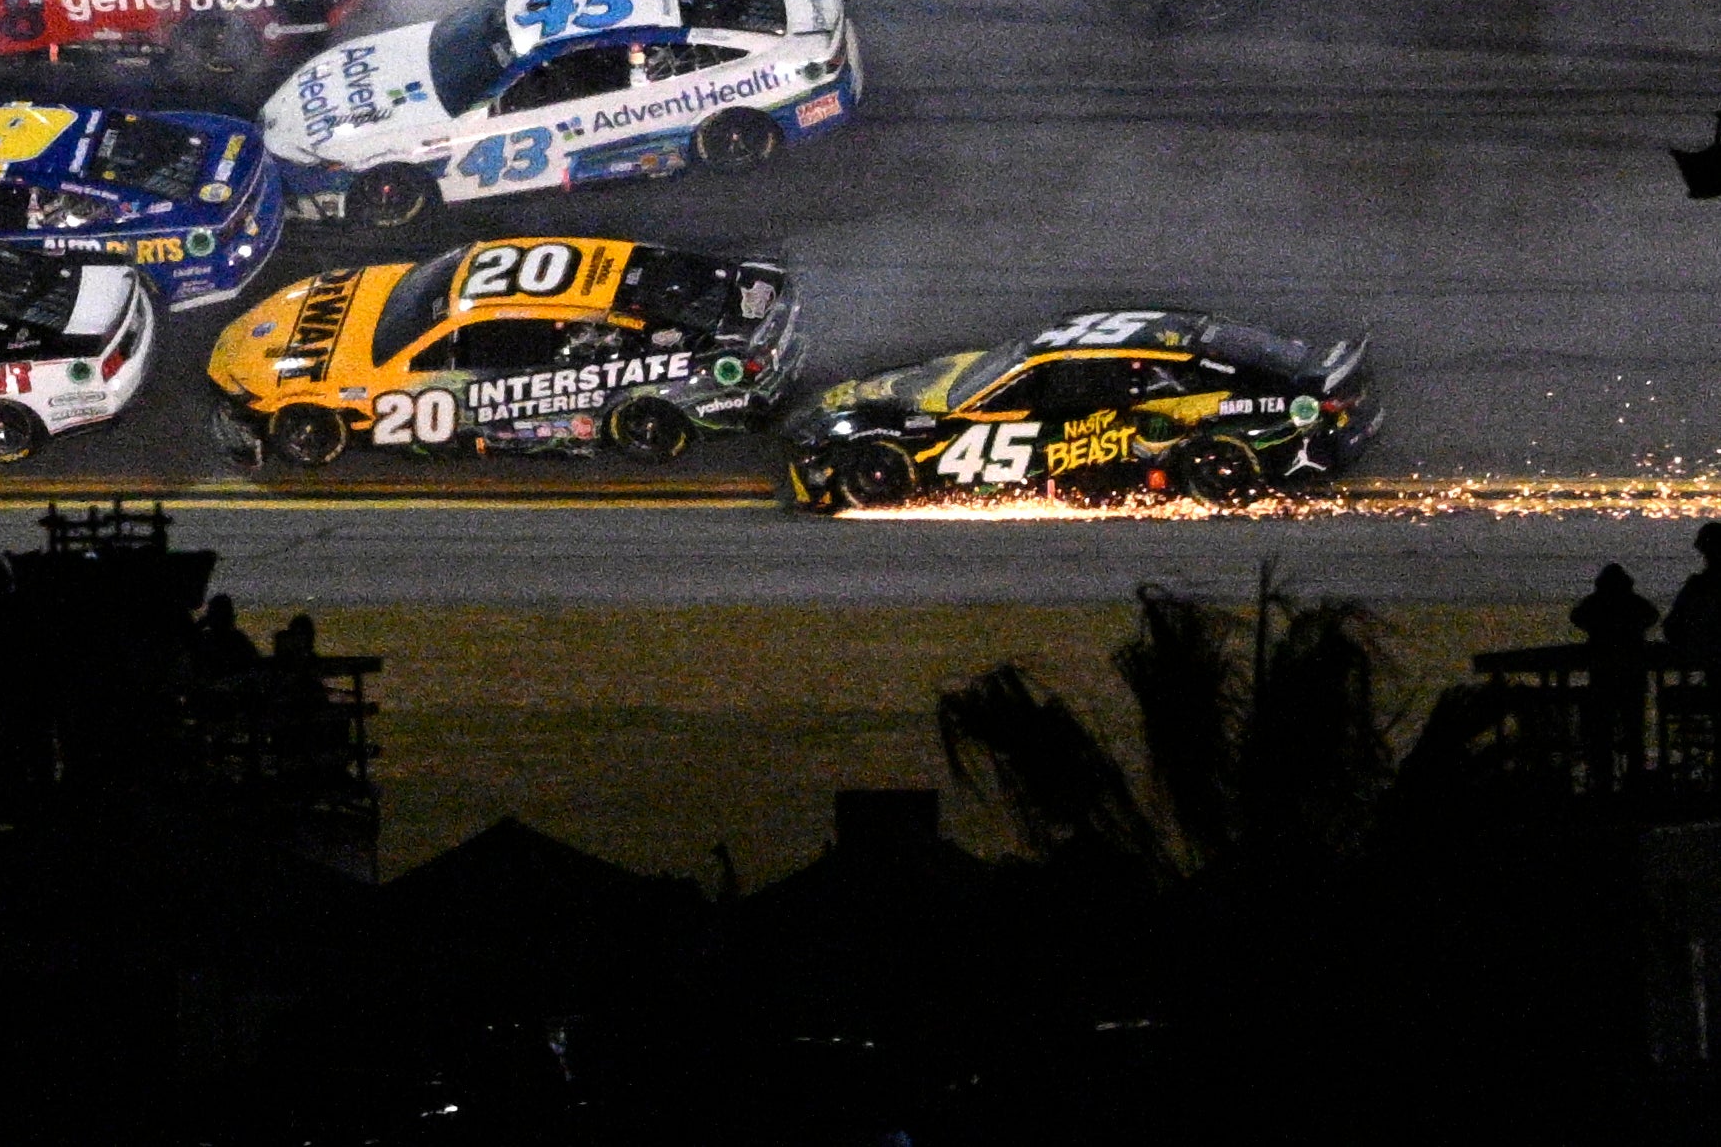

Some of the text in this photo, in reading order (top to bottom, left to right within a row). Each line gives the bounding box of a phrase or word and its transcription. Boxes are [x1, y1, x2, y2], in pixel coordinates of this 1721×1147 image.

[457, 126, 553, 189] 43
[462, 244, 574, 300] 20
[1032, 311, 1167, 347] 45
[468, 351, 693, 409] INTERSTATE
[373, 391, 457, 445] 20
[478, 389, 606, 424] BATTERIES
[1064, 408, 1118, 439] NASTY
[1218, 397, 1287, 416] HARD TEA
[937, 422, 1043, 483] 45
[1045, 426, 1140, 477] BEAST
